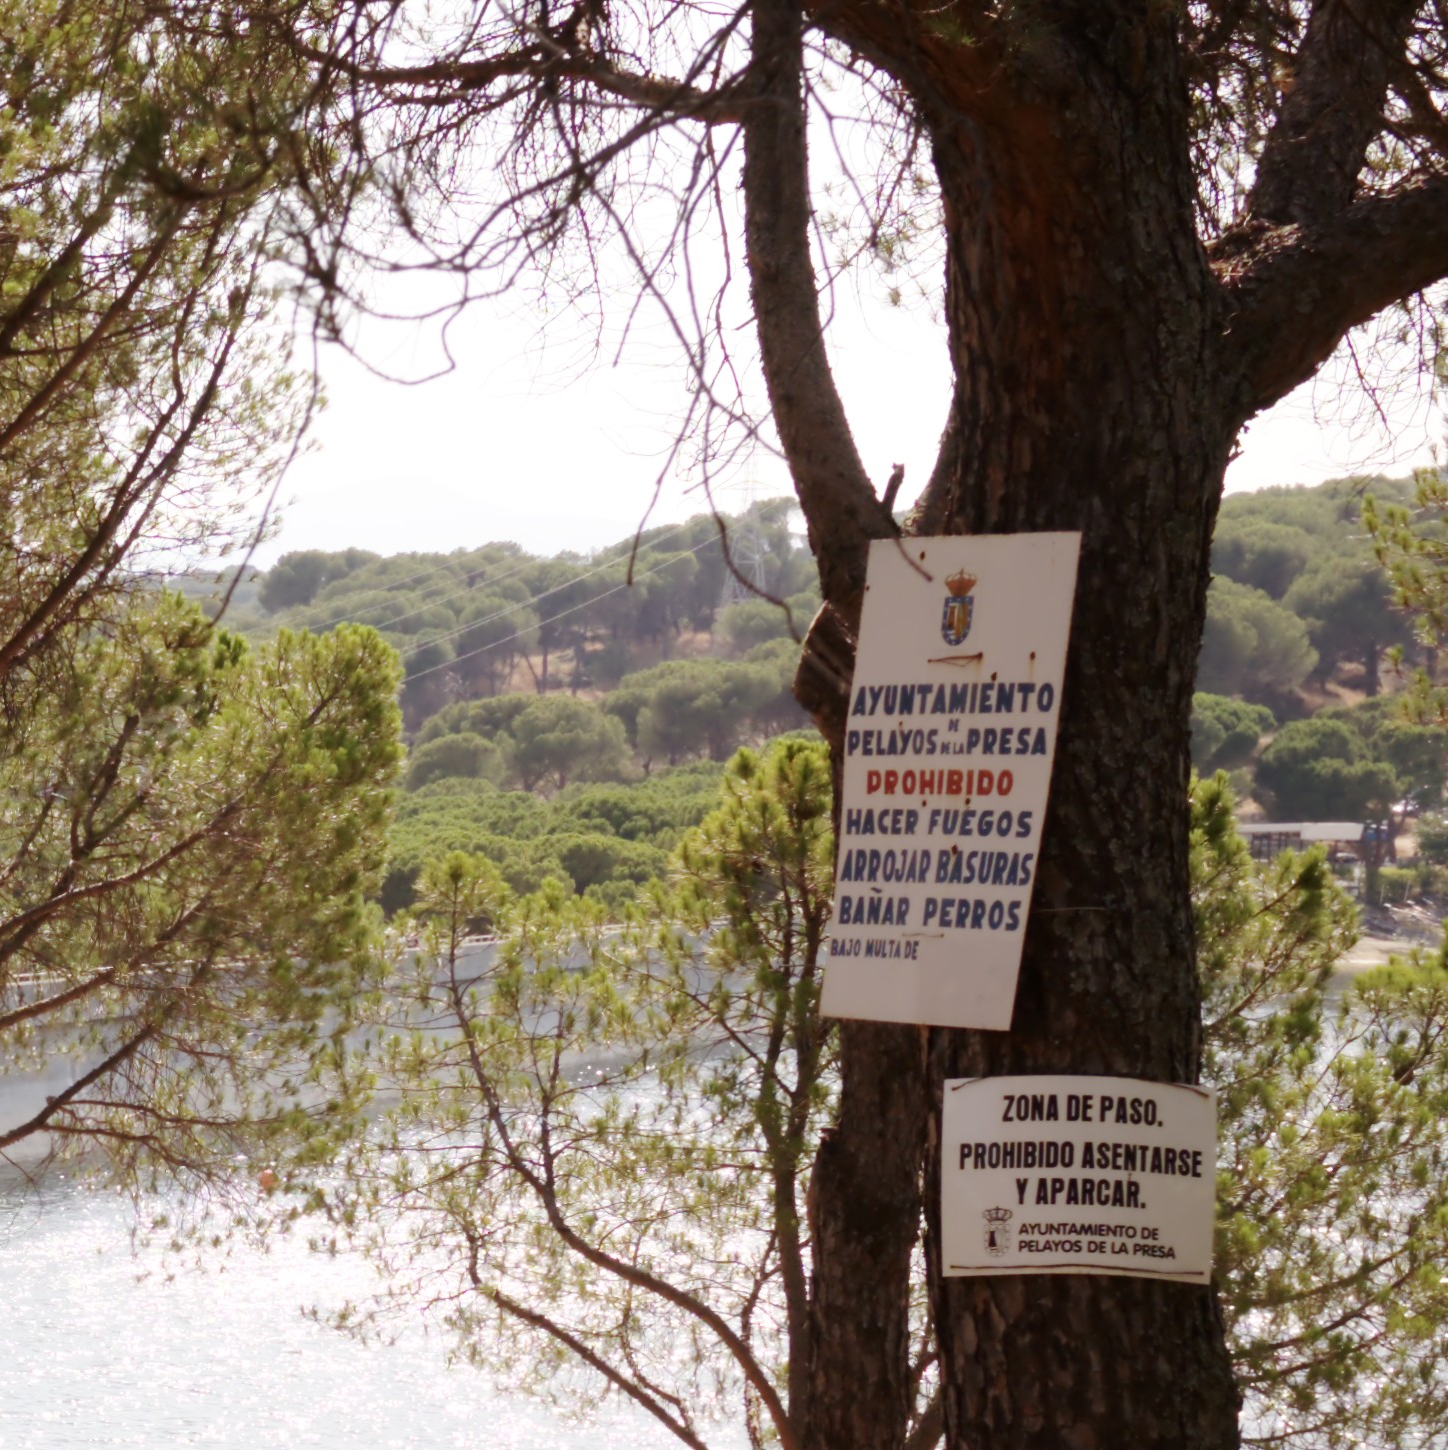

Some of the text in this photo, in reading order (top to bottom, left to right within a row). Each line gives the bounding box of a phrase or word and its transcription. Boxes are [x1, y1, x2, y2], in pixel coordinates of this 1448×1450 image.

[851, 682, 1055, 716] AYUNTAMIENTO
[948, 718, 960, 732] DE
[847, 727, 1048, 757] PELAYOS DE LA PRESA
[866, 769, 1014, 796] PROHIBIDO
[846, 808, 1033, 838] HACER FUEGOS
[840, 849, 1034, 887] ARROJAR BASURAS
[838, 886, 1022, 932] BAÑAR PERROS
[830, 938, 920, 961] BAJO MULTA DE
[1002, 1094, 1163, 1128] ZONA DE PASO.
[959, 1141, 1203, 1178] PROHIBIDO ASENTARSE
[1016, 1178, 1147, 1209] Y APARCAR.
[1018, 1222, 1159, 1241] AYUNTAMIENTO DE
[1018, 1239, 1177, 1260] PELAYOS DE LA PRESA
